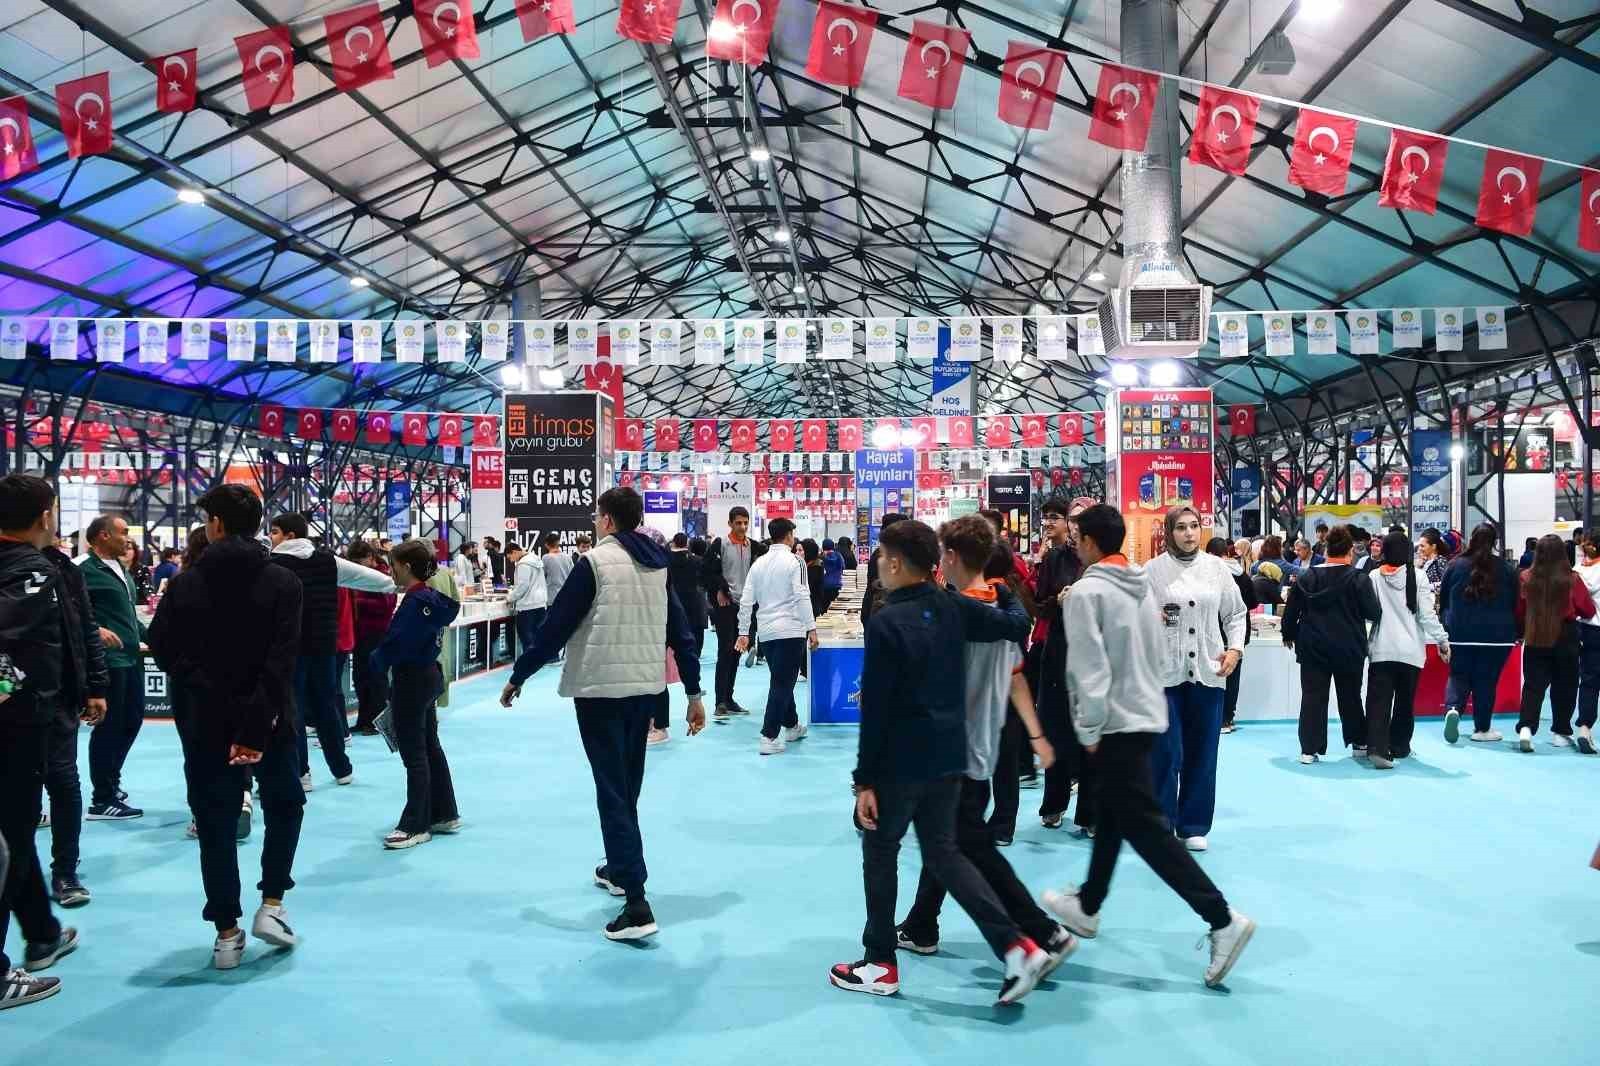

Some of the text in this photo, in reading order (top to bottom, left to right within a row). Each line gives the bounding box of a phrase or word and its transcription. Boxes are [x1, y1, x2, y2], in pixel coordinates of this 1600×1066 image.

[942, 396, 961, 406] HOŞ
[1152, 393, 1180, 402] ALFA
[533, 413, 594, 442] timaş
[508, 432, 583, 452] yayın grubu
[866, 451, 904, 468] Hayat
[532, 468, 593, 487] GENÇ
[857, 469, 913, 485] Yayınları
[532, 488, 593, 507] TİMAŞ
